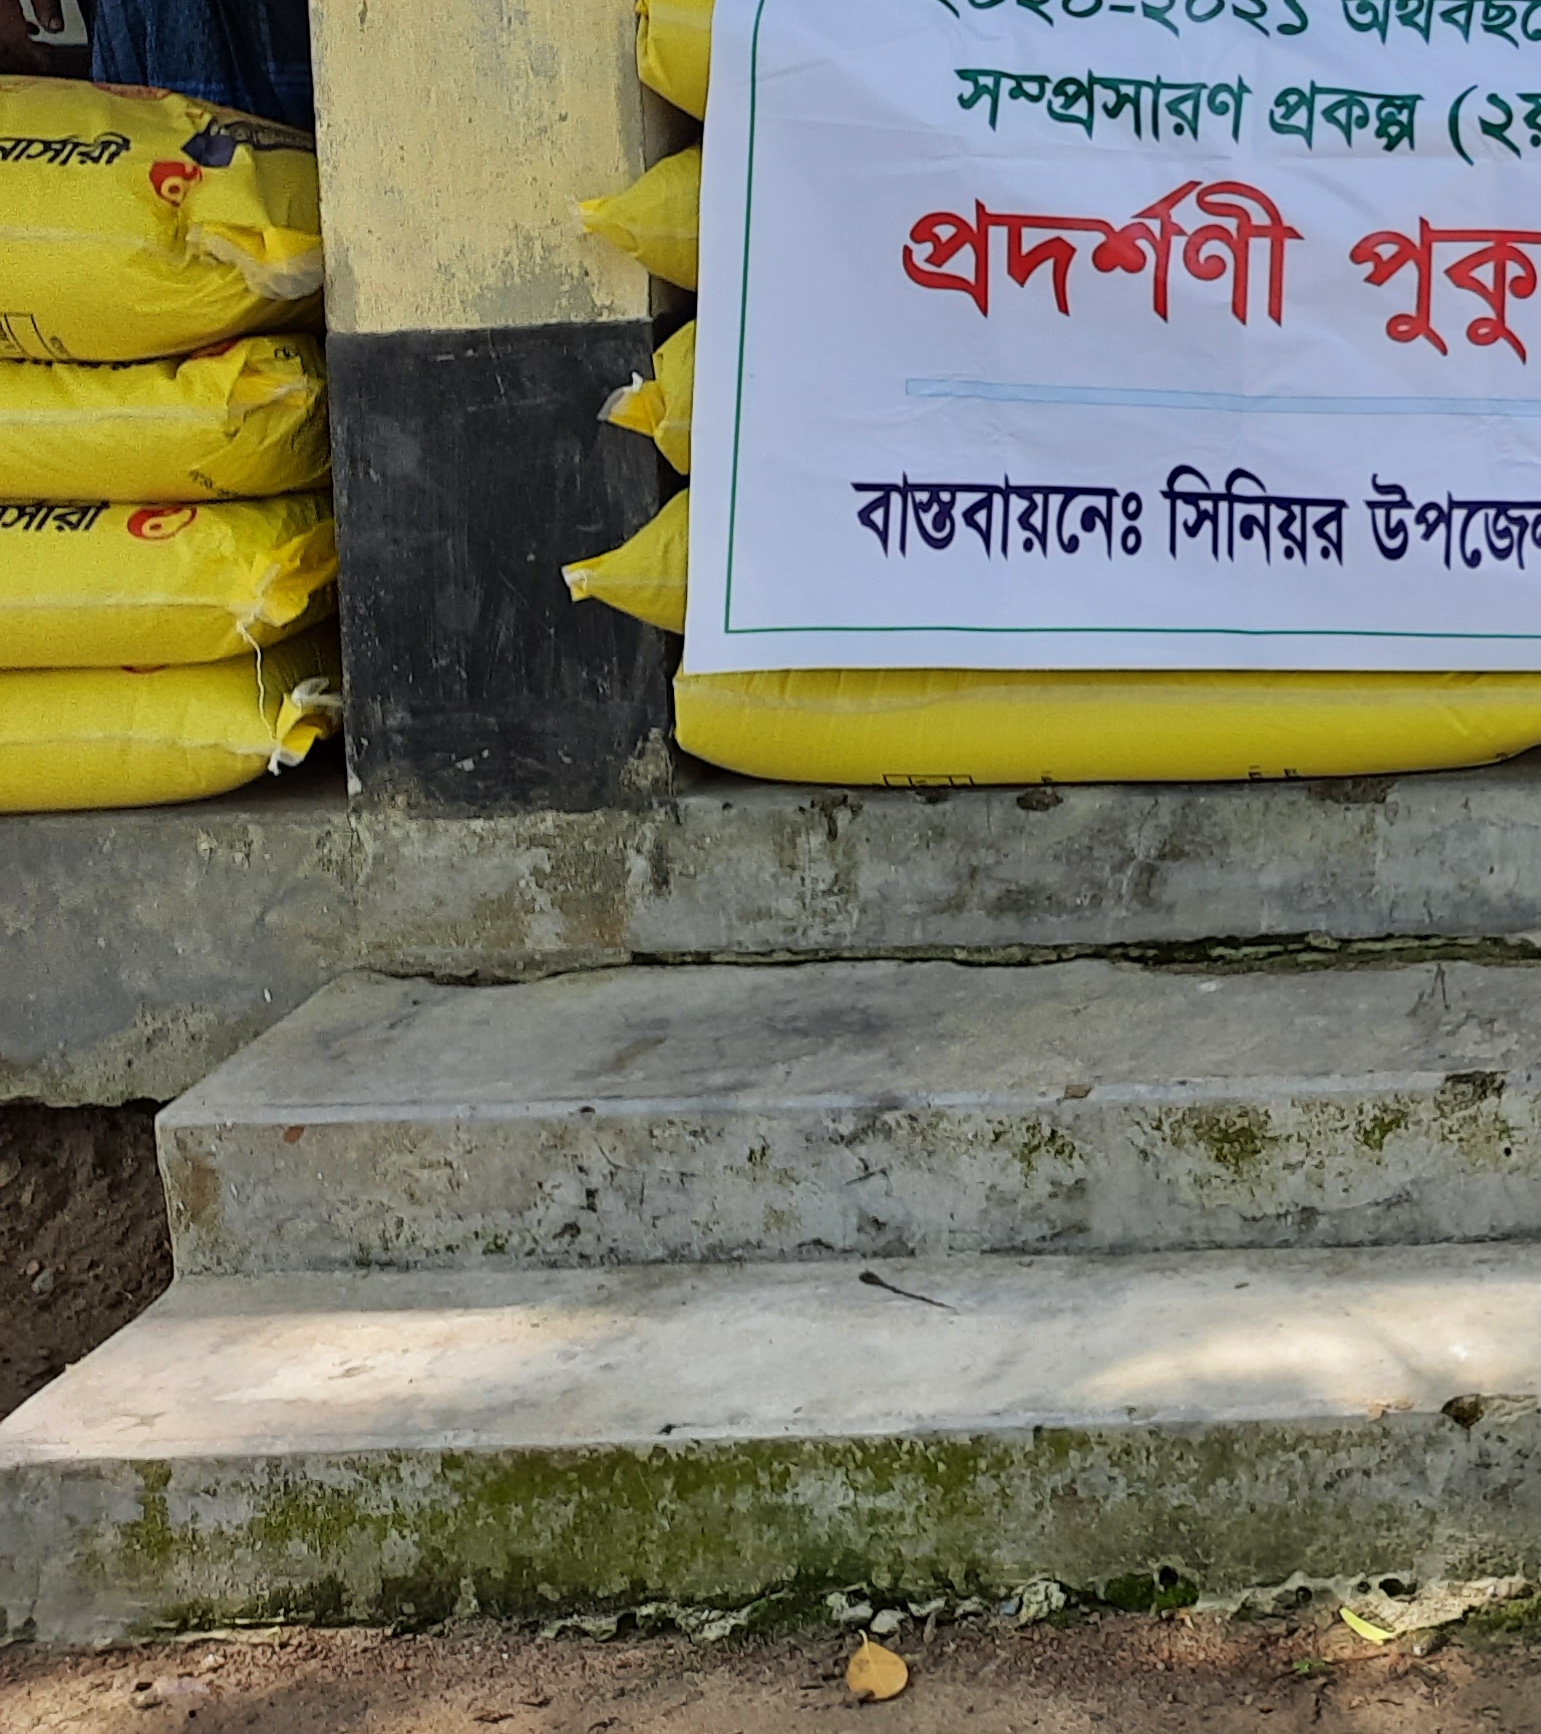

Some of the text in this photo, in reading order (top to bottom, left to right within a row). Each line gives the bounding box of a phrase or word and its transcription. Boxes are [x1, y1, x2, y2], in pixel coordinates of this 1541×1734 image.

[954, 69, 1252, 143] সম্প্রসারণ
[1269, 80, 1424, 152] প্রকল্প
[903, 181, 1304, 326] প্রদর্শণী
[1159, 465, 1349, 566] সিনিয়র
